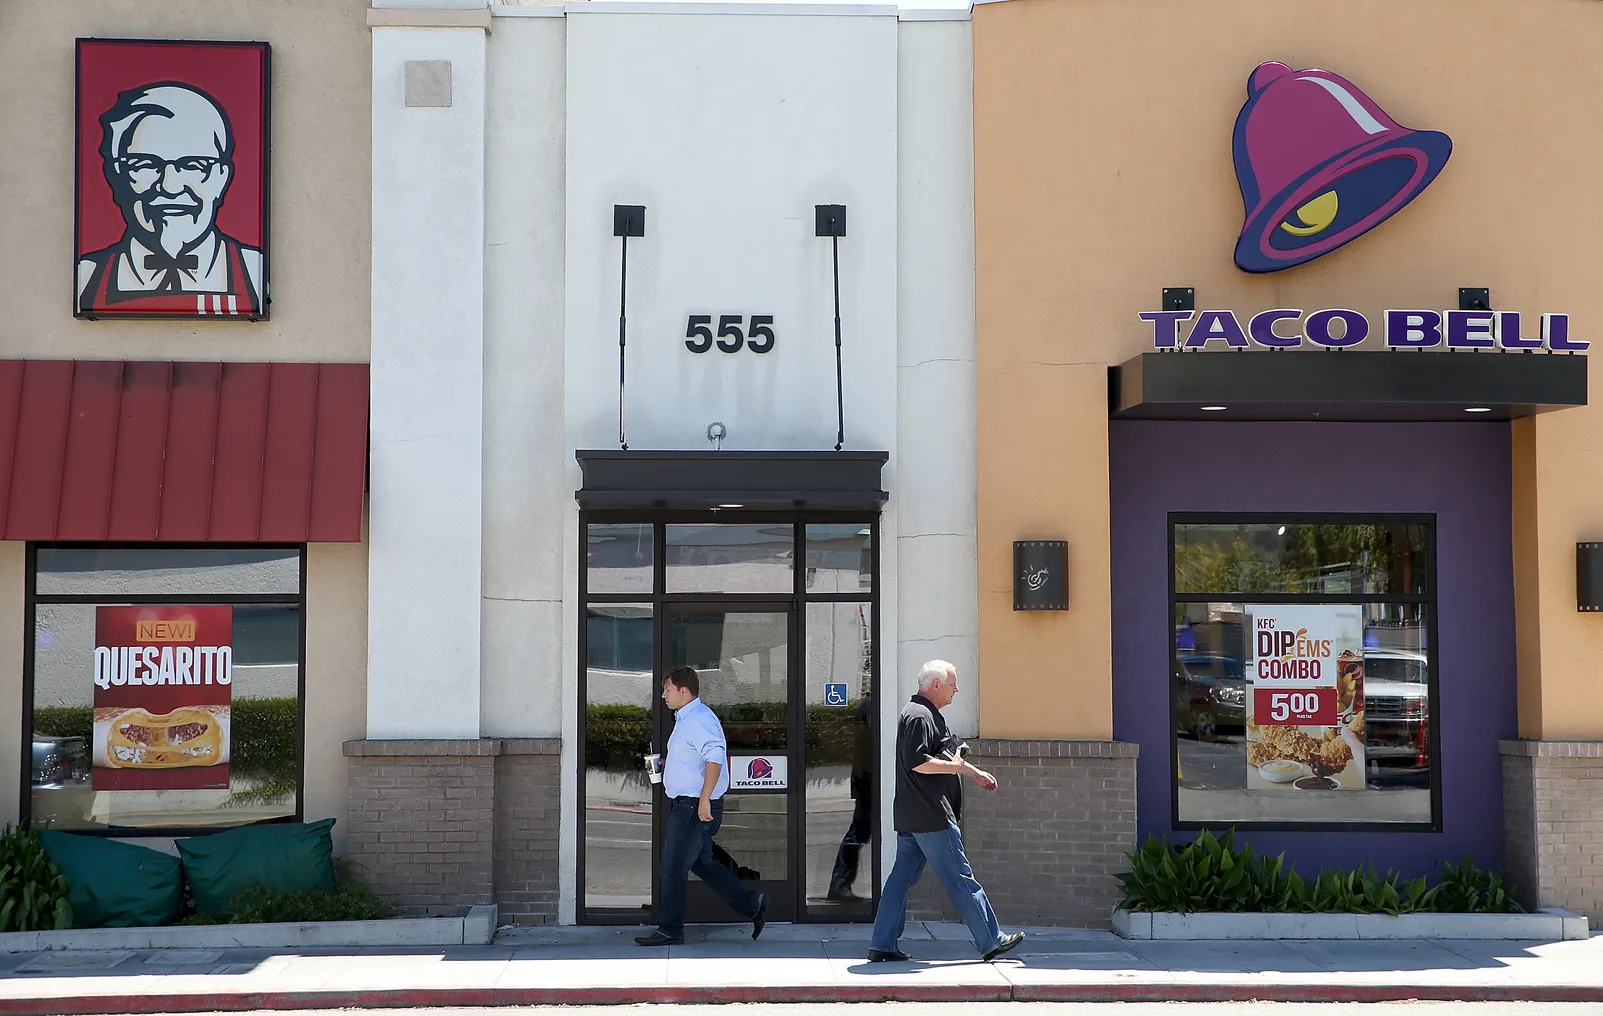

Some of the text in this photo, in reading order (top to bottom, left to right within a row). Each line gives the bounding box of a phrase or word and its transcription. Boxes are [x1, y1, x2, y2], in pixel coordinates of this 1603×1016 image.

[685, 314, 775, 354] 555
[1138, 308, 1591, 351] TACO BELL
[140, 623, 192, 639] NEW!
[1257, 618, 1275, 629] KFC
[94, 645, 232, 691] QUESARITO
[1258, 659, 1322, 680] COMBO
